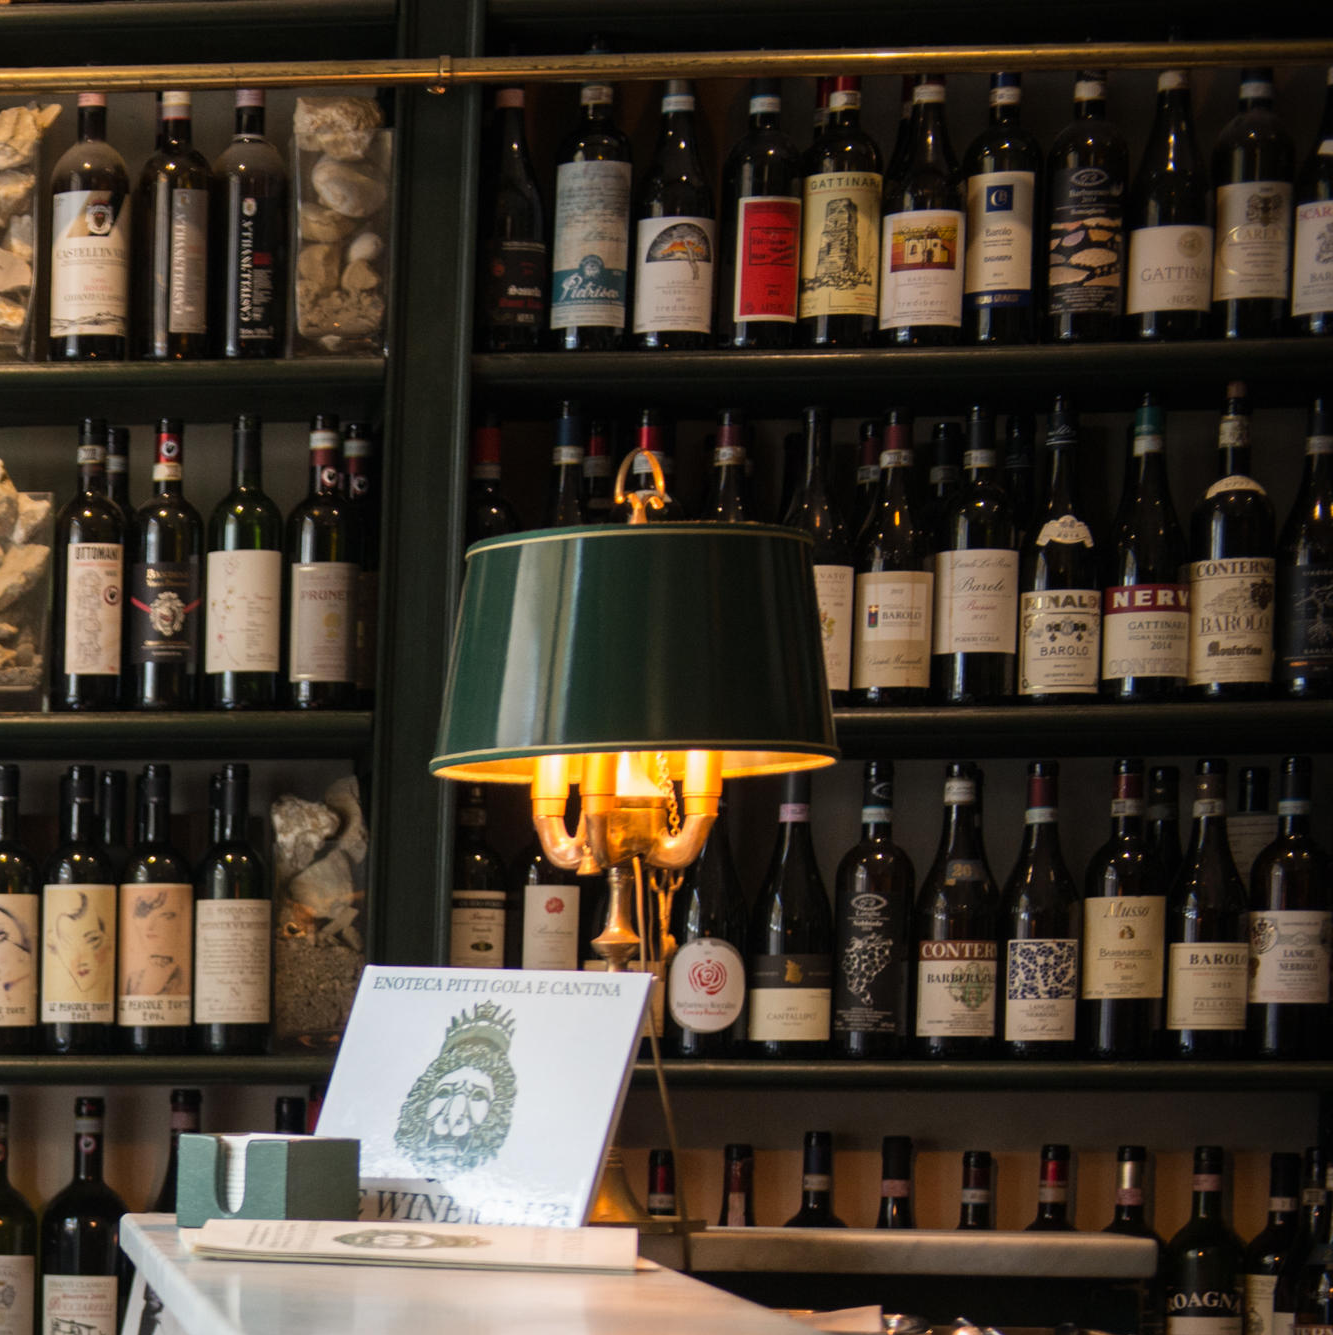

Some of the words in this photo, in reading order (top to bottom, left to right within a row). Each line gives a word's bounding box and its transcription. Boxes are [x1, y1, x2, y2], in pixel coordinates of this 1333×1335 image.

[1069, 189, 1111, 198] Barbaresco
[985, 227, 1013, 238] Barolo
[906, 275, 940, 283] BAROLO
[953, 577, 1006, 593] Barolo
[882, 610, 923, 621] BAROLO
[1200, 615, 1272, 635] BAROLO
[1040, 645, 1090, 657] BAROLO
[1150, 641, 1173, 651] 2014
[854, 909, 882, 918] Langhe
[1102, 900, 1150, 919] Musso
[851, 919, 885, 928] Nebbiolo
[1098, 947, 1153, 958] BARBARESCO
[1282, 948, 1316, 958] LANGHE
[1113, 961, 1137, 971] PORA
[1278, 962, 1319, 972] NEBBIOLO
[926, 973, 977, 984] BARBERA
[373, 976, 443, 992] ENOTECA
[445, 978, 489, 993] PITTI
[490, 979, 533, 994] GOLA
[535, 981, 547, 994] E
[550, 981, 622, 997] CANTINA
[129, 1001, 164, 1012] PERGOLE
[766, 1012, 818, 1022] CANTALUPO
[376, 1190, 463, 1224] WINE
